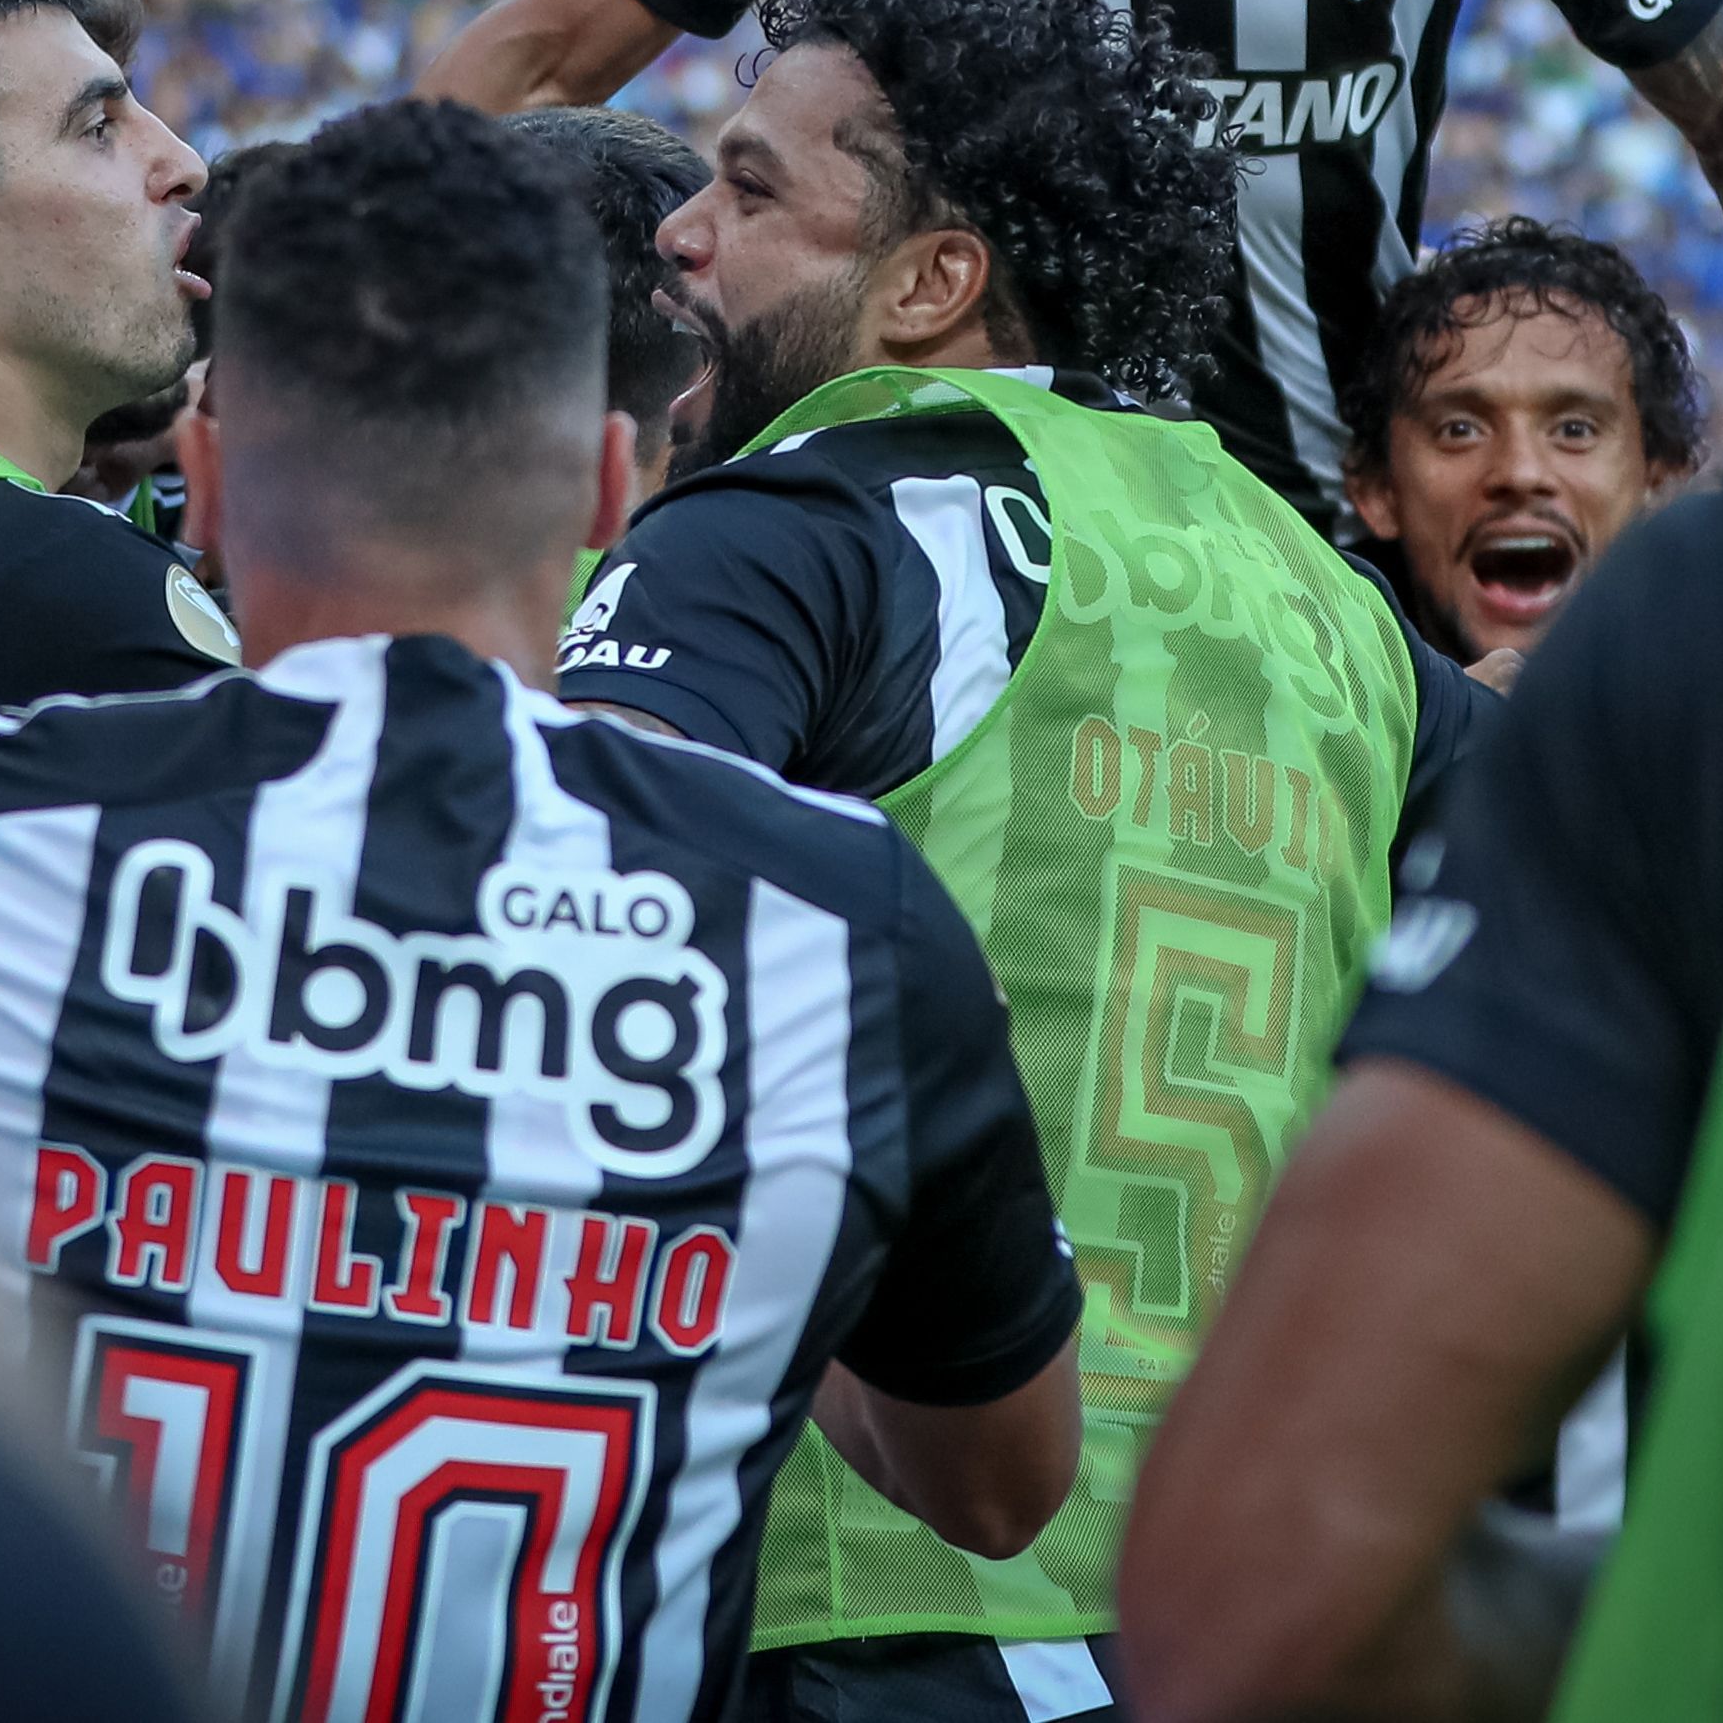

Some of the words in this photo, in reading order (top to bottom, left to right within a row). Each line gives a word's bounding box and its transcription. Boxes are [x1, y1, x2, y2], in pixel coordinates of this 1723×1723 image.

[1192, 62, 1398, 150] TANO
[554, 639, 673, 674] DAU
[502, 886, 671, 938] GALO
[268, 887, 704, 1154] bmg
[26, 1143, 739, 1358] PAULINHO
